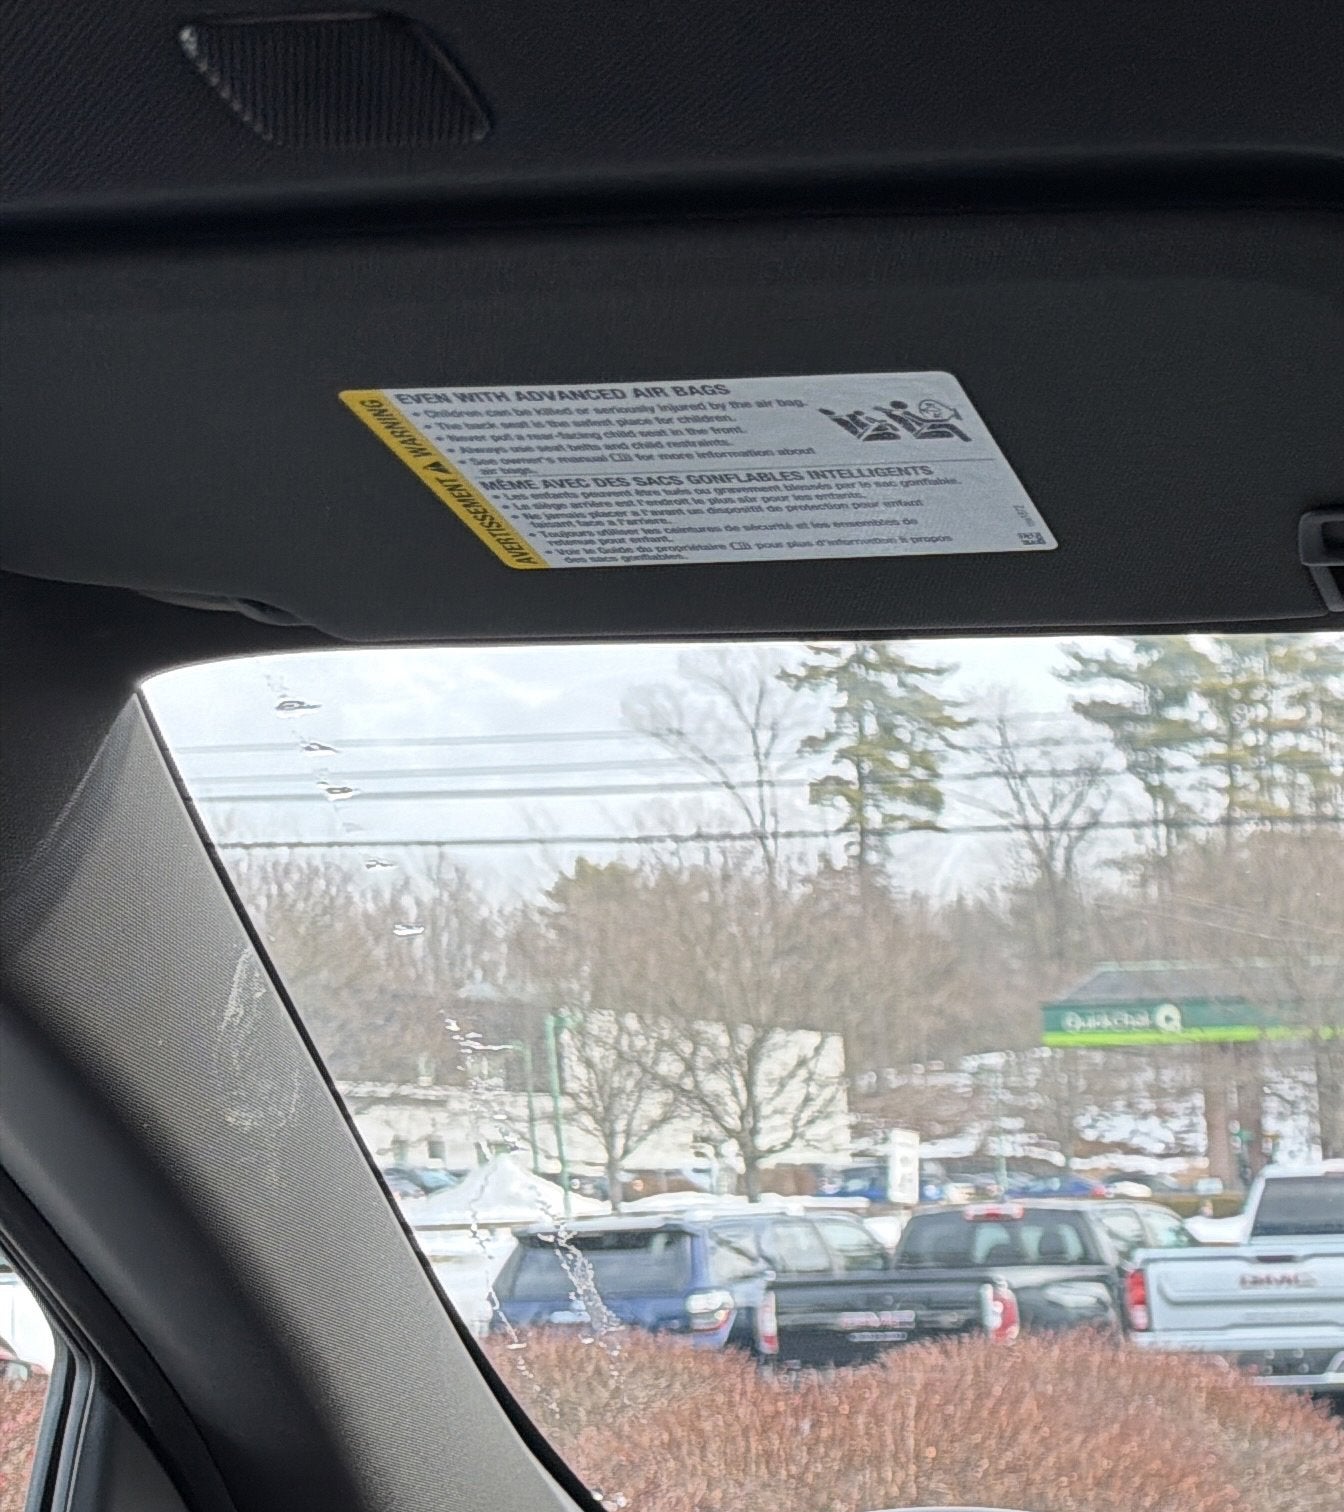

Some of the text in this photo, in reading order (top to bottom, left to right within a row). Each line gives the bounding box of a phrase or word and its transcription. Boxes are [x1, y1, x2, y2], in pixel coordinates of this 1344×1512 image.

[394, 384, 731, 405] EVEN WITH ADVANCED AIR BAGS
[659, 401, 706, 412] injured
[708, 401, 727, 411] by
[730, 400, 752, 409] the
[756, 399, 772, 408] air
[360, 399, 432, 458] WARNING
[655, 416, 674, 425] for
[686, 427, 709, 436] the
[478, 478, 540, 491] MÊME
[542, 476, 590, 489] AVEC
[593, 476, 630, 488] DES
[633, 474, 683, 487] SACS
[687, 470, 804, 485] GONFLABLES
[807, 465, 935, 480] INTELLIGENTS
[435, 477, 538, 566] AVERTISSEMENT
